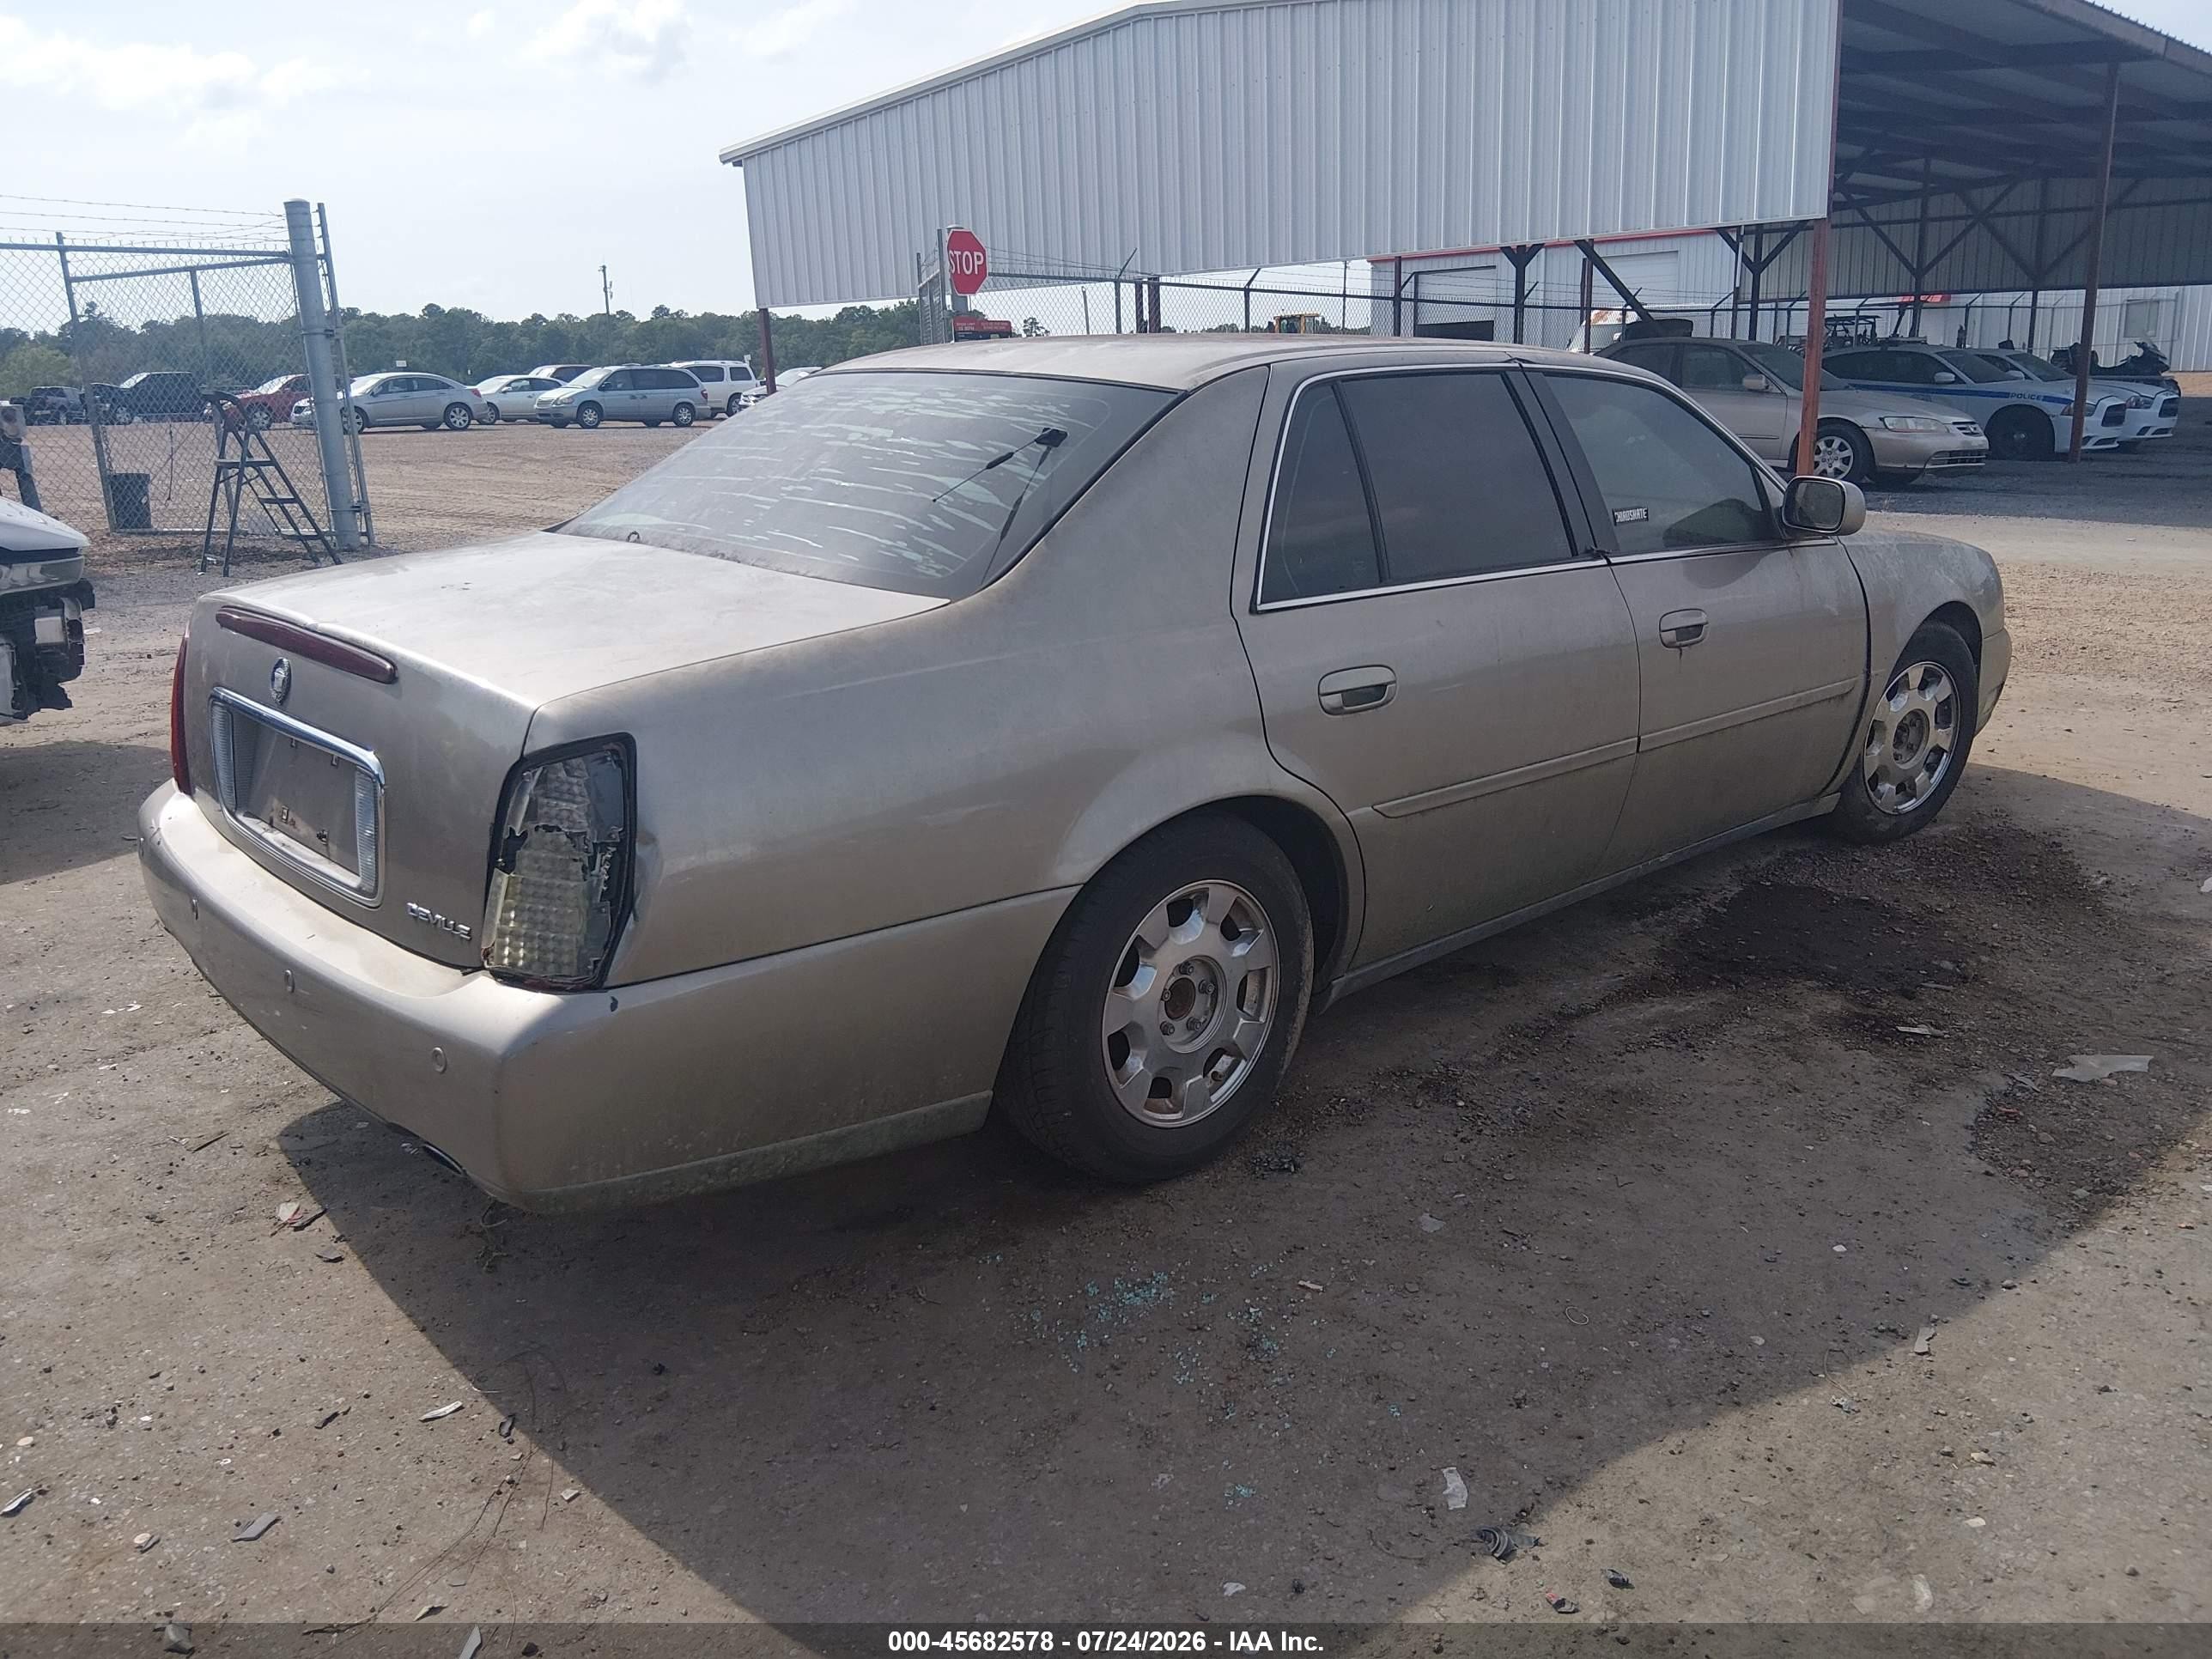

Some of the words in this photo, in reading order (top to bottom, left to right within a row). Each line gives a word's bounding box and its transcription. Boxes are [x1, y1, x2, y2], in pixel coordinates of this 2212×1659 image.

[949, 250, 984, 275] STOP
[2010, 392, 2043, 401] POLICE
[406, 902, 471, 940] DEVILLE
